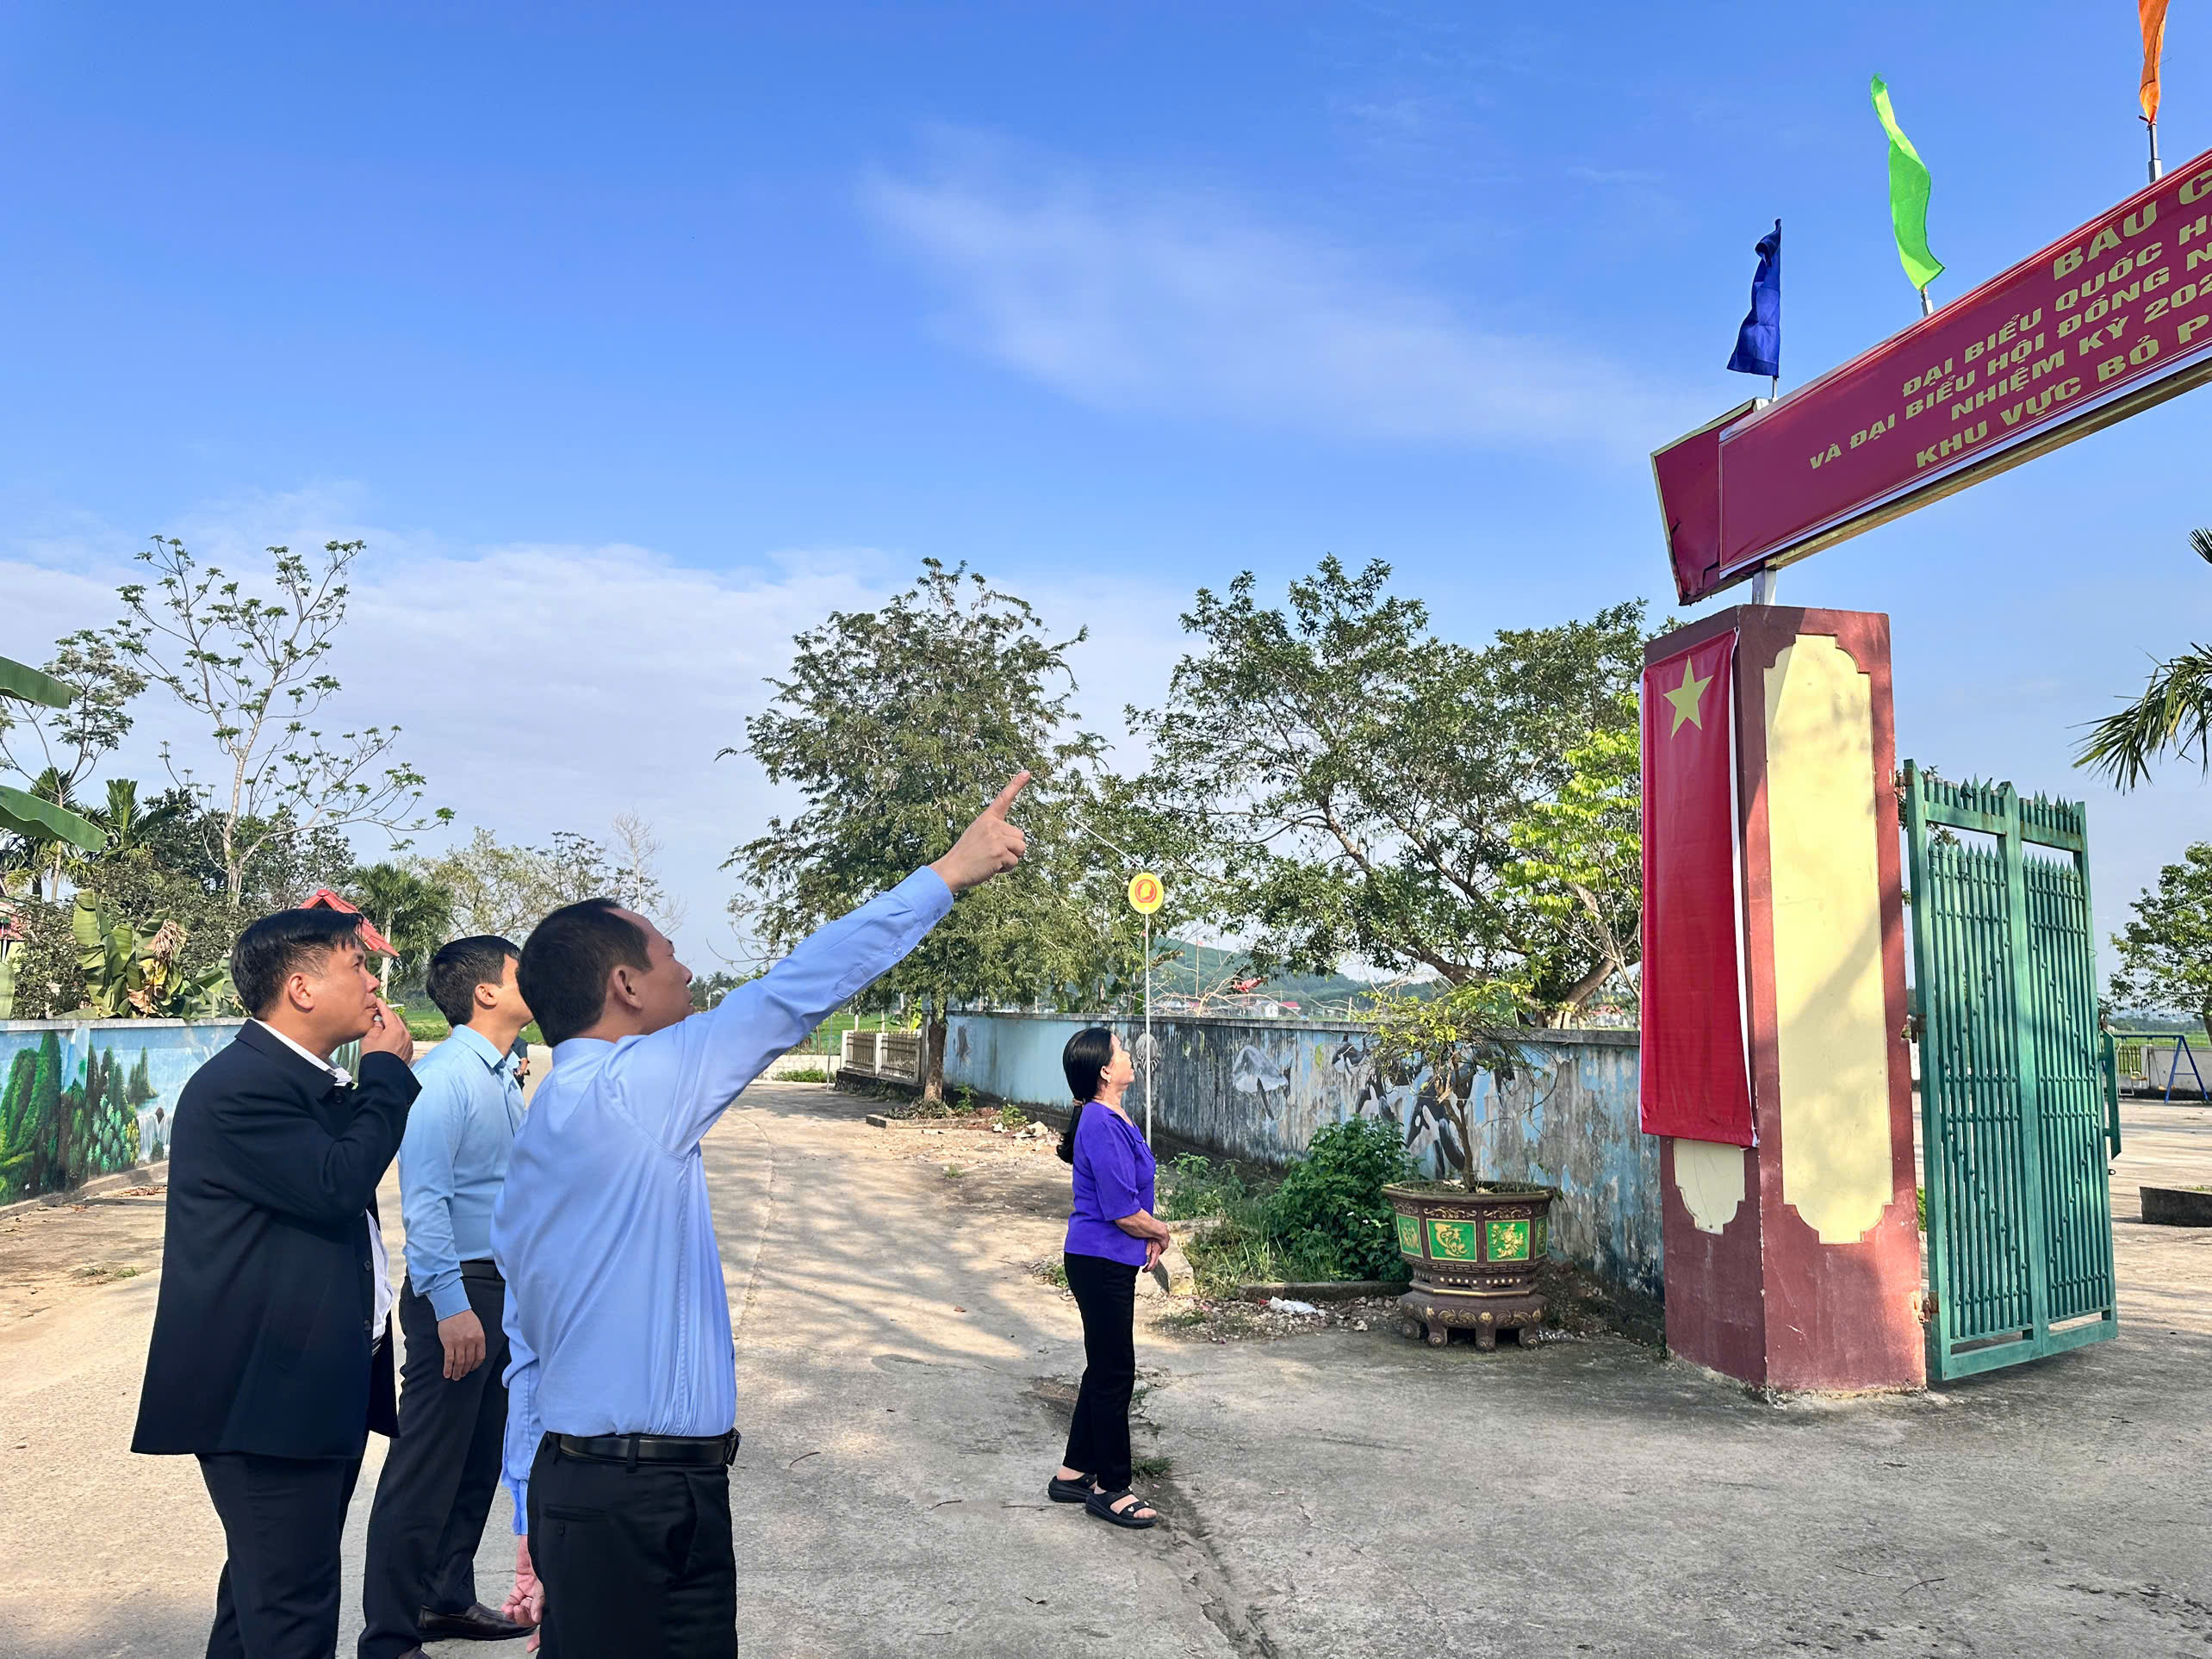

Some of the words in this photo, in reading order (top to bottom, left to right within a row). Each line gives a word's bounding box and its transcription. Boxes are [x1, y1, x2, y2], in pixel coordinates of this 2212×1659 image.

[1810, 443, 1842, 469] VÀ
[1849, 413, 1896, 450] ĐẠI
[1905, 370, 1976, 420] BIỂU
[1987, 332, 2045, 376] HỘI
[2057, 266, 2170, 339] ĐỒNG
[1902, 357, 1954, 398] ĐẠI
[1964, 308, 2042, 363] BIỂU
[2055, 242, 2163, 312] QUỐC
[2178, 214, 2212, 246] H
[1951, 349, 2065, 421] NHIỆM
[2078, 315, 2129, 356] KỲ
[1916, 419, 1988, 469] KHU
[1999, 376, 2082, 426] VỰC
[2097, 334, 2159, 382] BỎ
[2178, 314, 2209, 345] P
